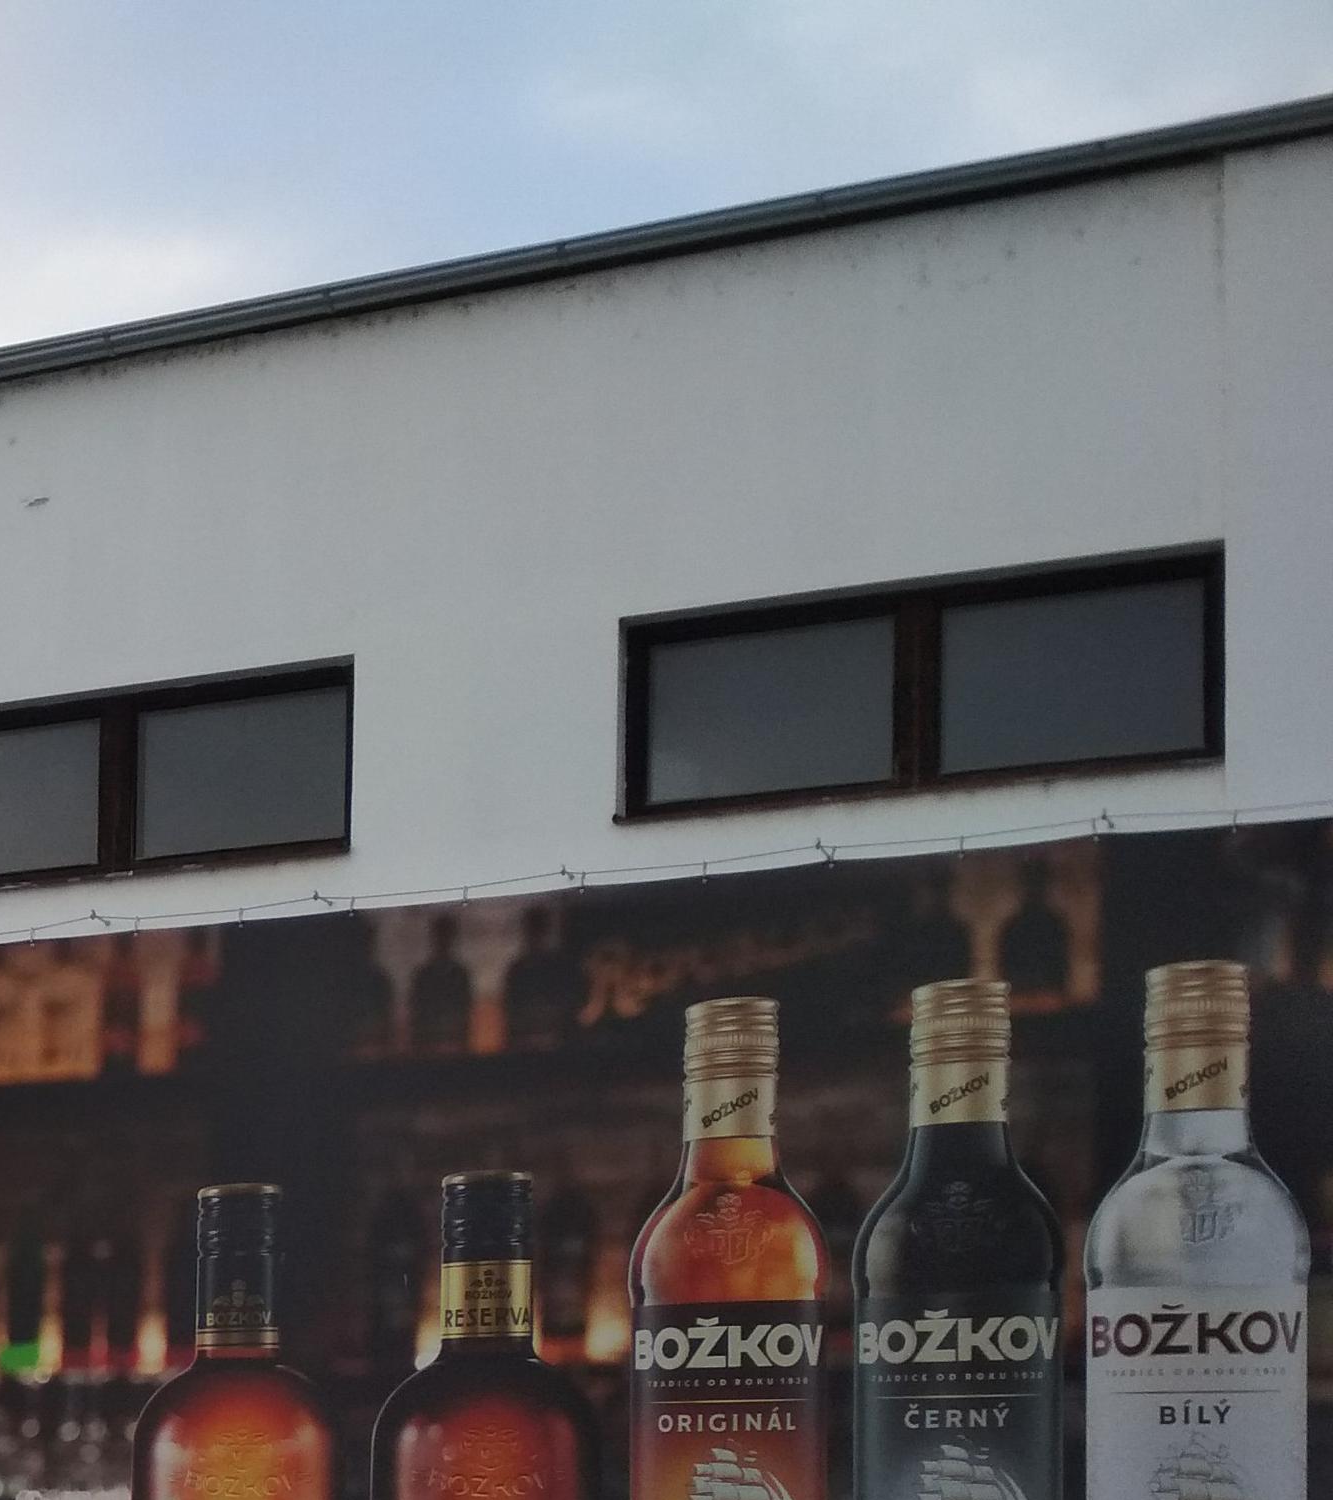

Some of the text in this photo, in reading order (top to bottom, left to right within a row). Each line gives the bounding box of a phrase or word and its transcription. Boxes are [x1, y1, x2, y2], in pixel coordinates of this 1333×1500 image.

[444, 1306, 531, 1329] RESERVA
[1091, 1303, 1302, 1358] BOŽKOV
[635, 1316, 824, 1371] BOŽKOV
[858, 1308, 1059, 1365] BOŽKOV
[657, 1406, 797, 1433] ORIGINÁL
[904, 1402, 1011, 1429] ČERNÝ
[1159, 1398, 1232, 1425] BÍLÝ
